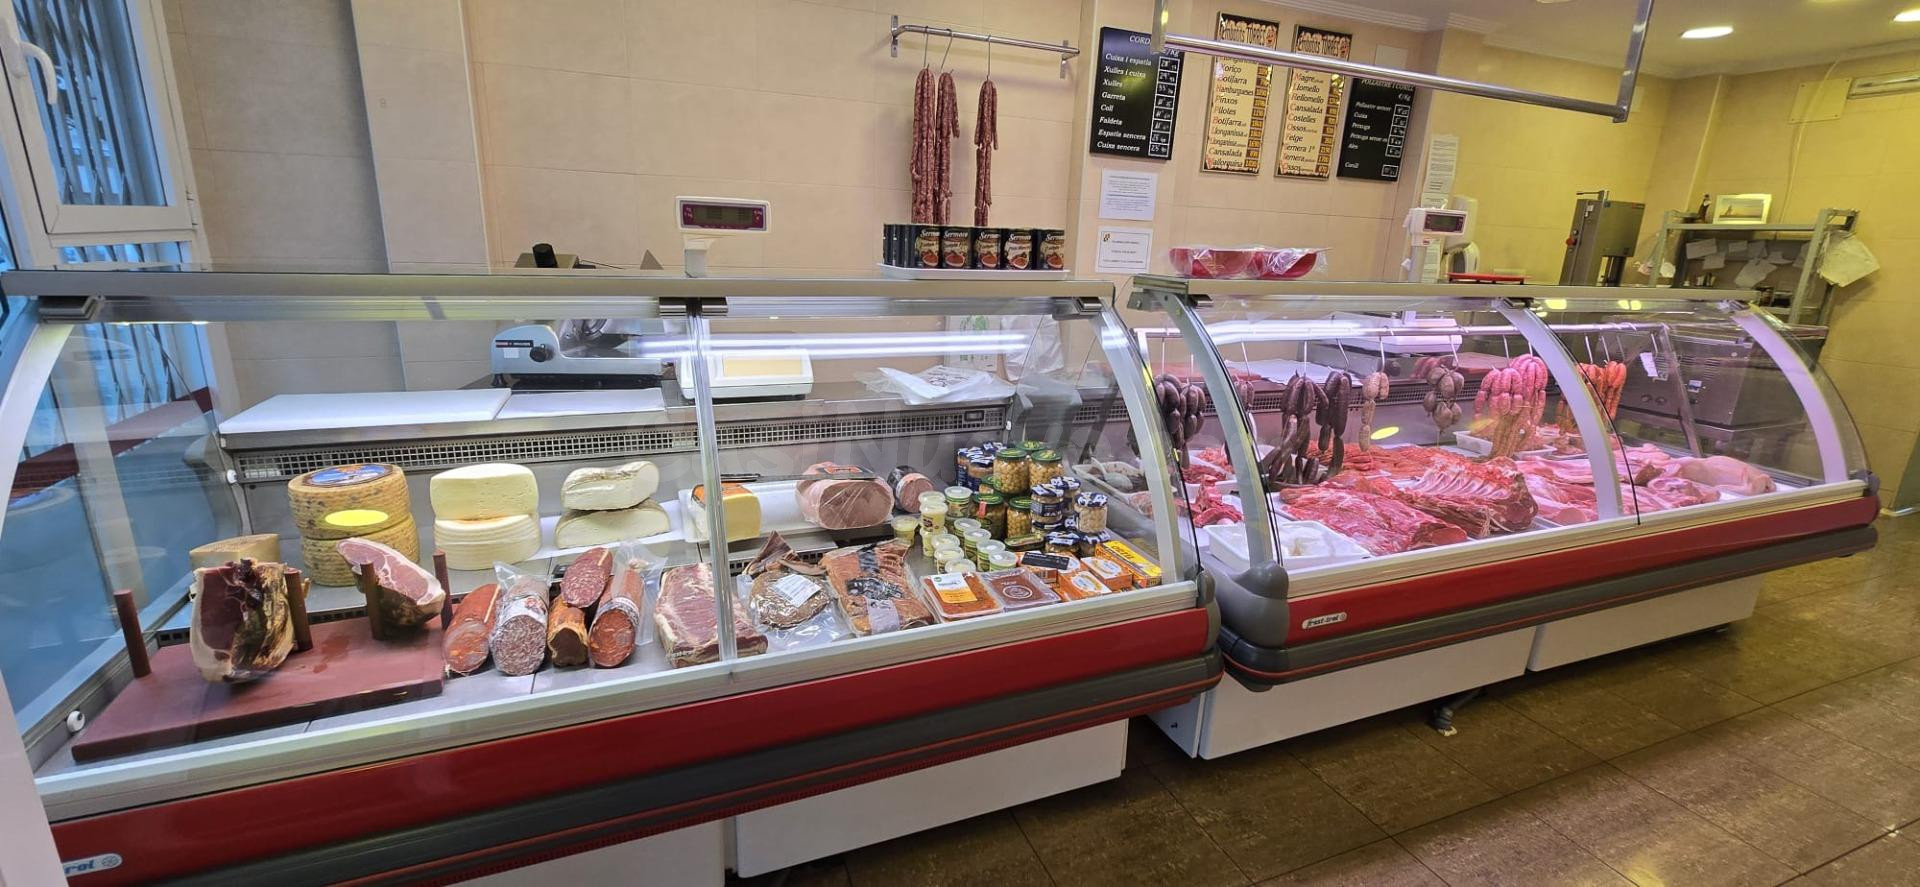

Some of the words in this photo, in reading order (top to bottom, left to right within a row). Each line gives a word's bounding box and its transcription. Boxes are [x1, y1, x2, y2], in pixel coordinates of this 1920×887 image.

[1101, 91, 1126, 101] Garreta
[1100, 103, 1114, 112] Coll
[1099, 116, 1123, 126] Faldeta
